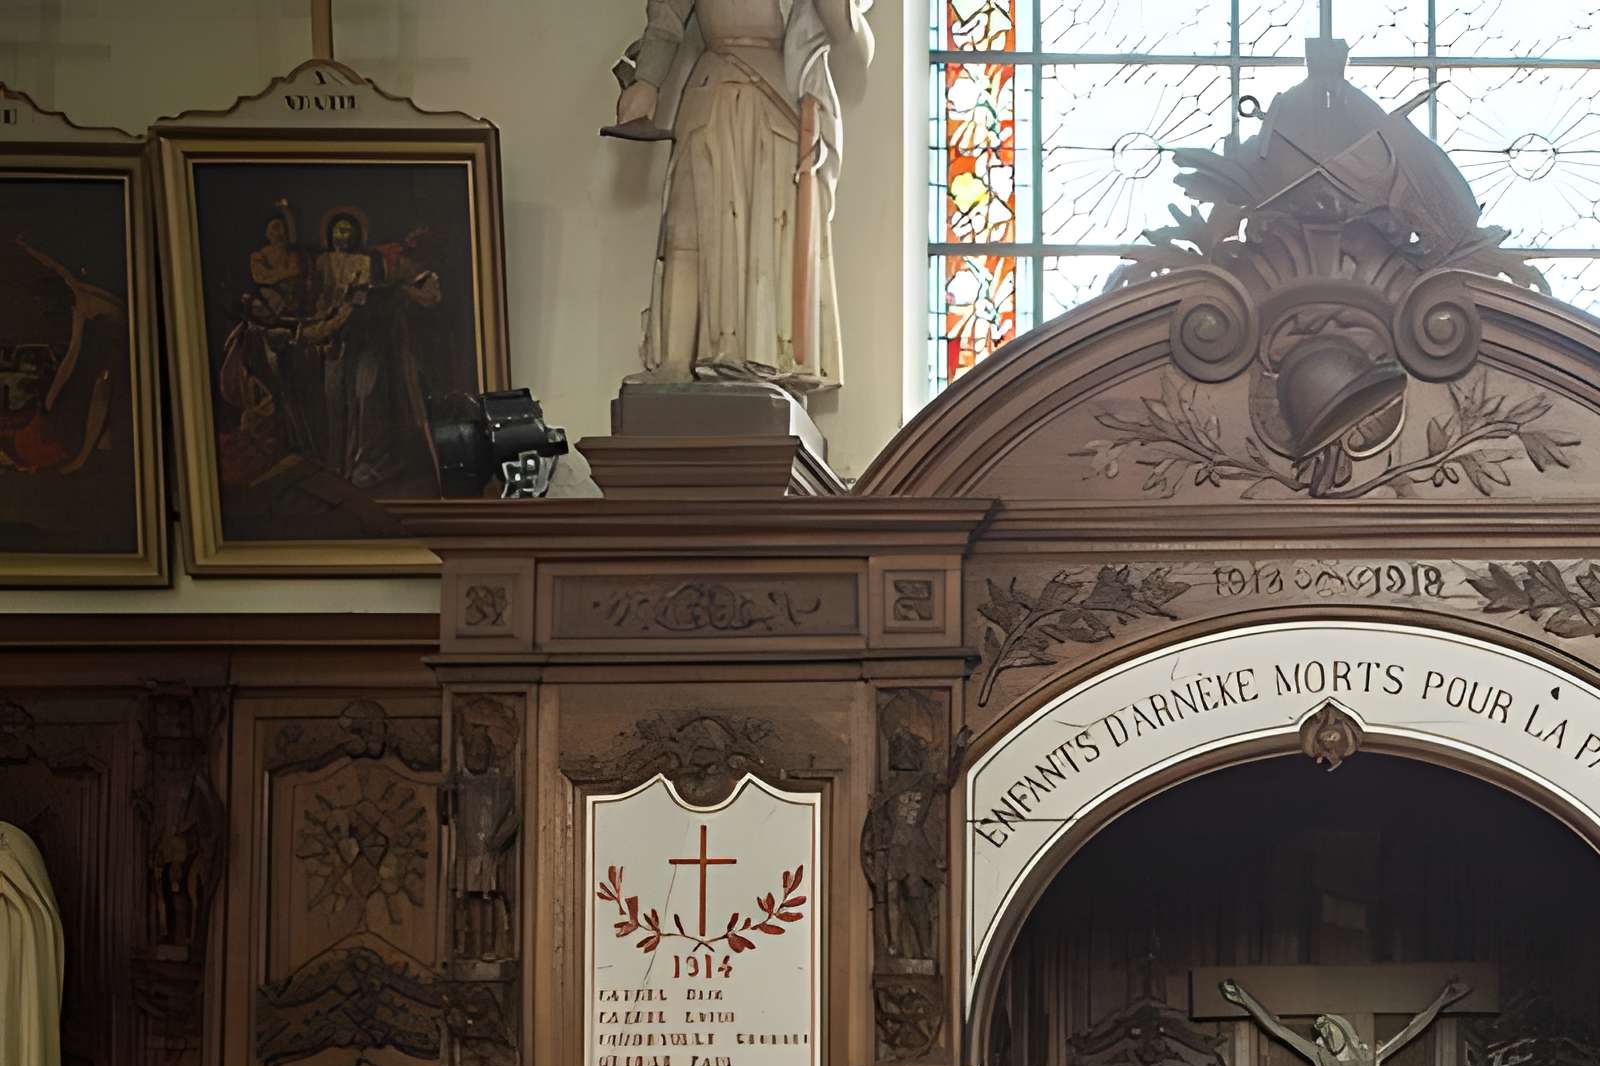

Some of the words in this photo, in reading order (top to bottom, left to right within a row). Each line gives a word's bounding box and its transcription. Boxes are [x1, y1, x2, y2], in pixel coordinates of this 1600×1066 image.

[975, 729, 1100, 848] ENFANTS
[1275, 660, 1405, 696] MORTS
[1421, 670, 1514, 724] POUR
[1523, 704, 1568, 749] LA
[673, 954, 734, 979] 1914
